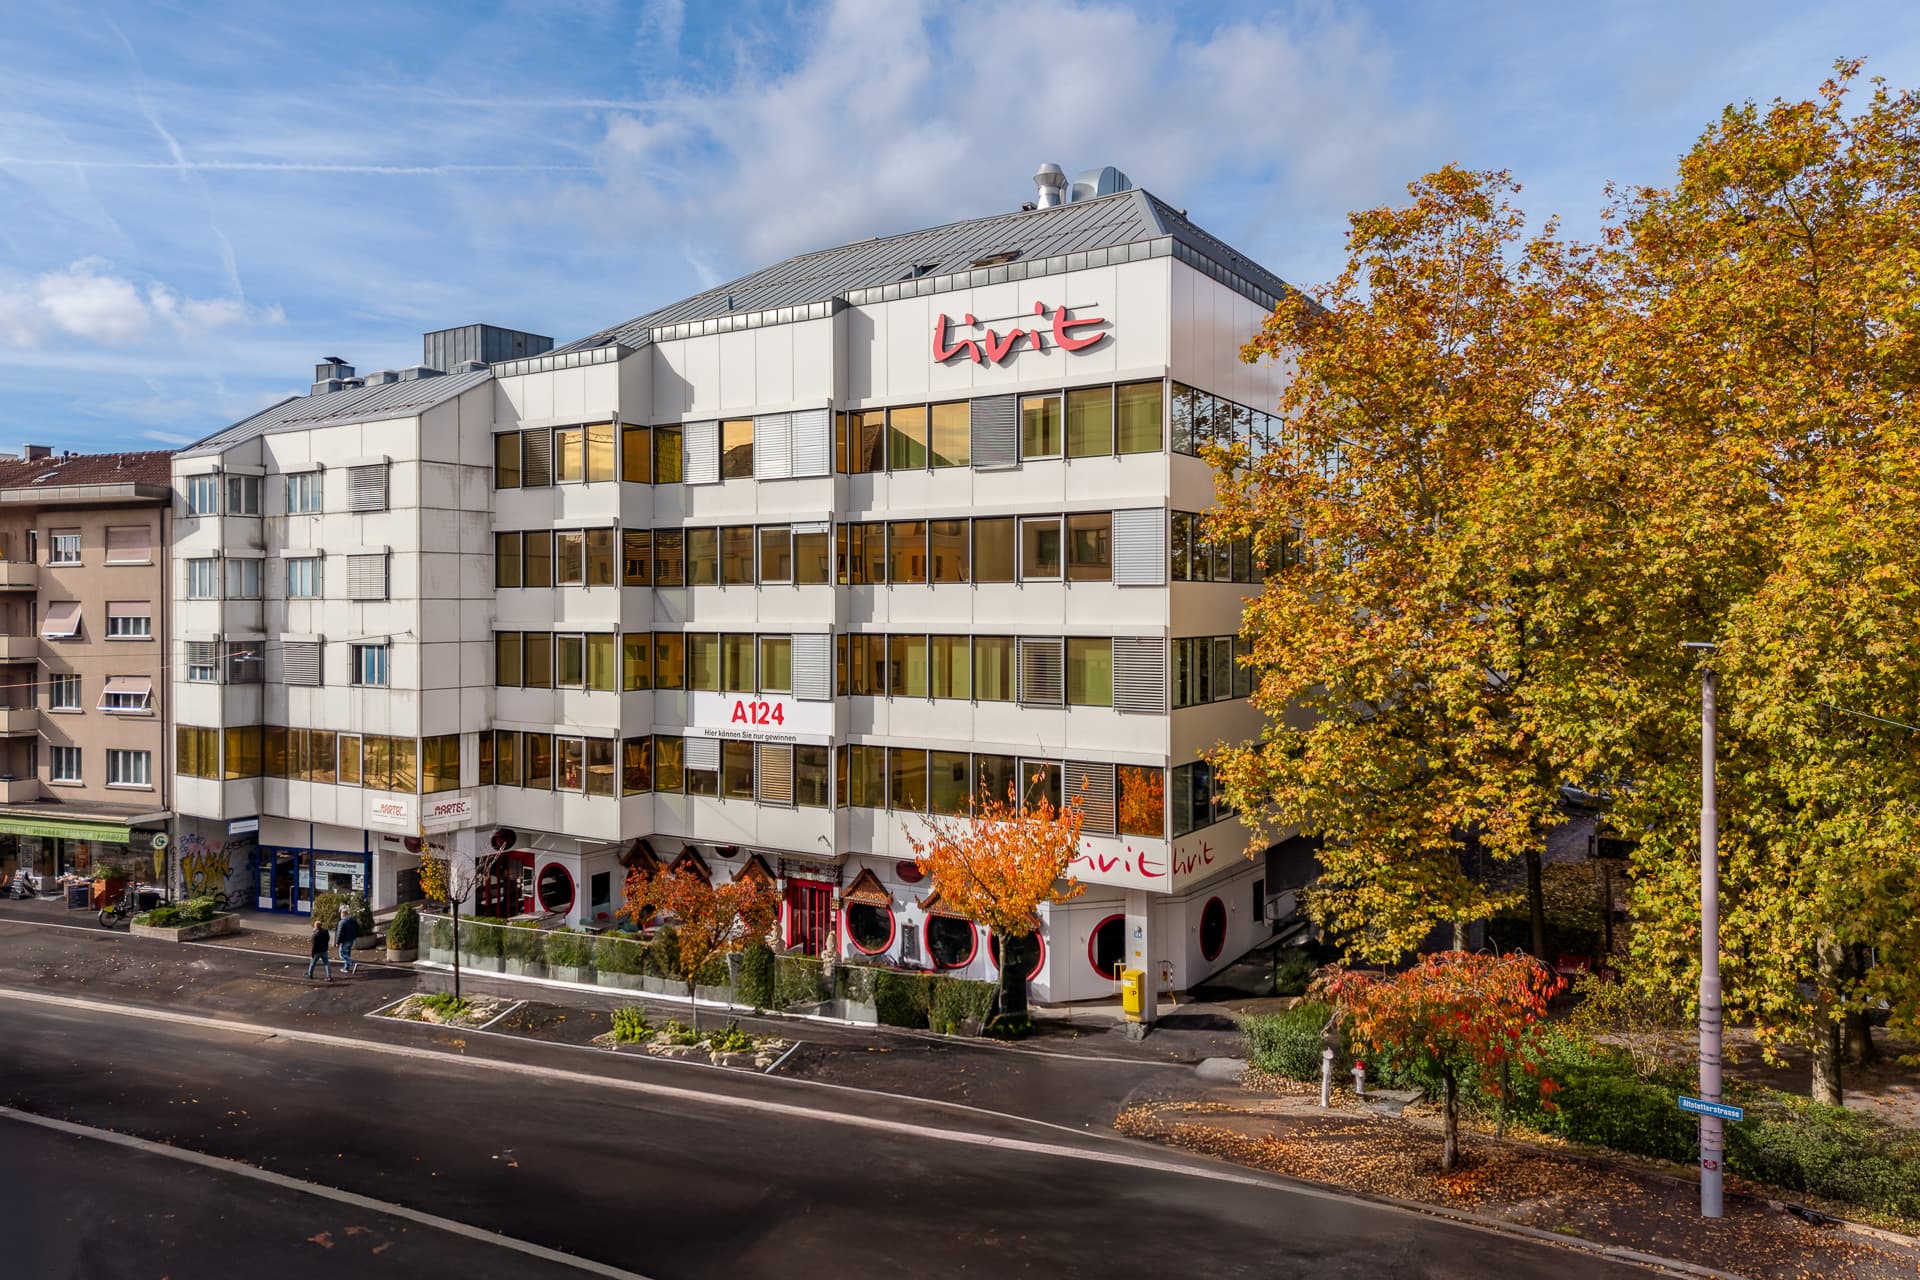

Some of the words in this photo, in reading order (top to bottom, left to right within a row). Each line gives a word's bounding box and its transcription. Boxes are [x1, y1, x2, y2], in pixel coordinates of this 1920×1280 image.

[731, 700, 785, 726] A124
[704, 729, 718, 737] Hier
[719, 730, 741, 738] können
[765, 734, 797, 742] gewinnen
[1683, 1099, 1740, 1118] Altstetterstrasse
